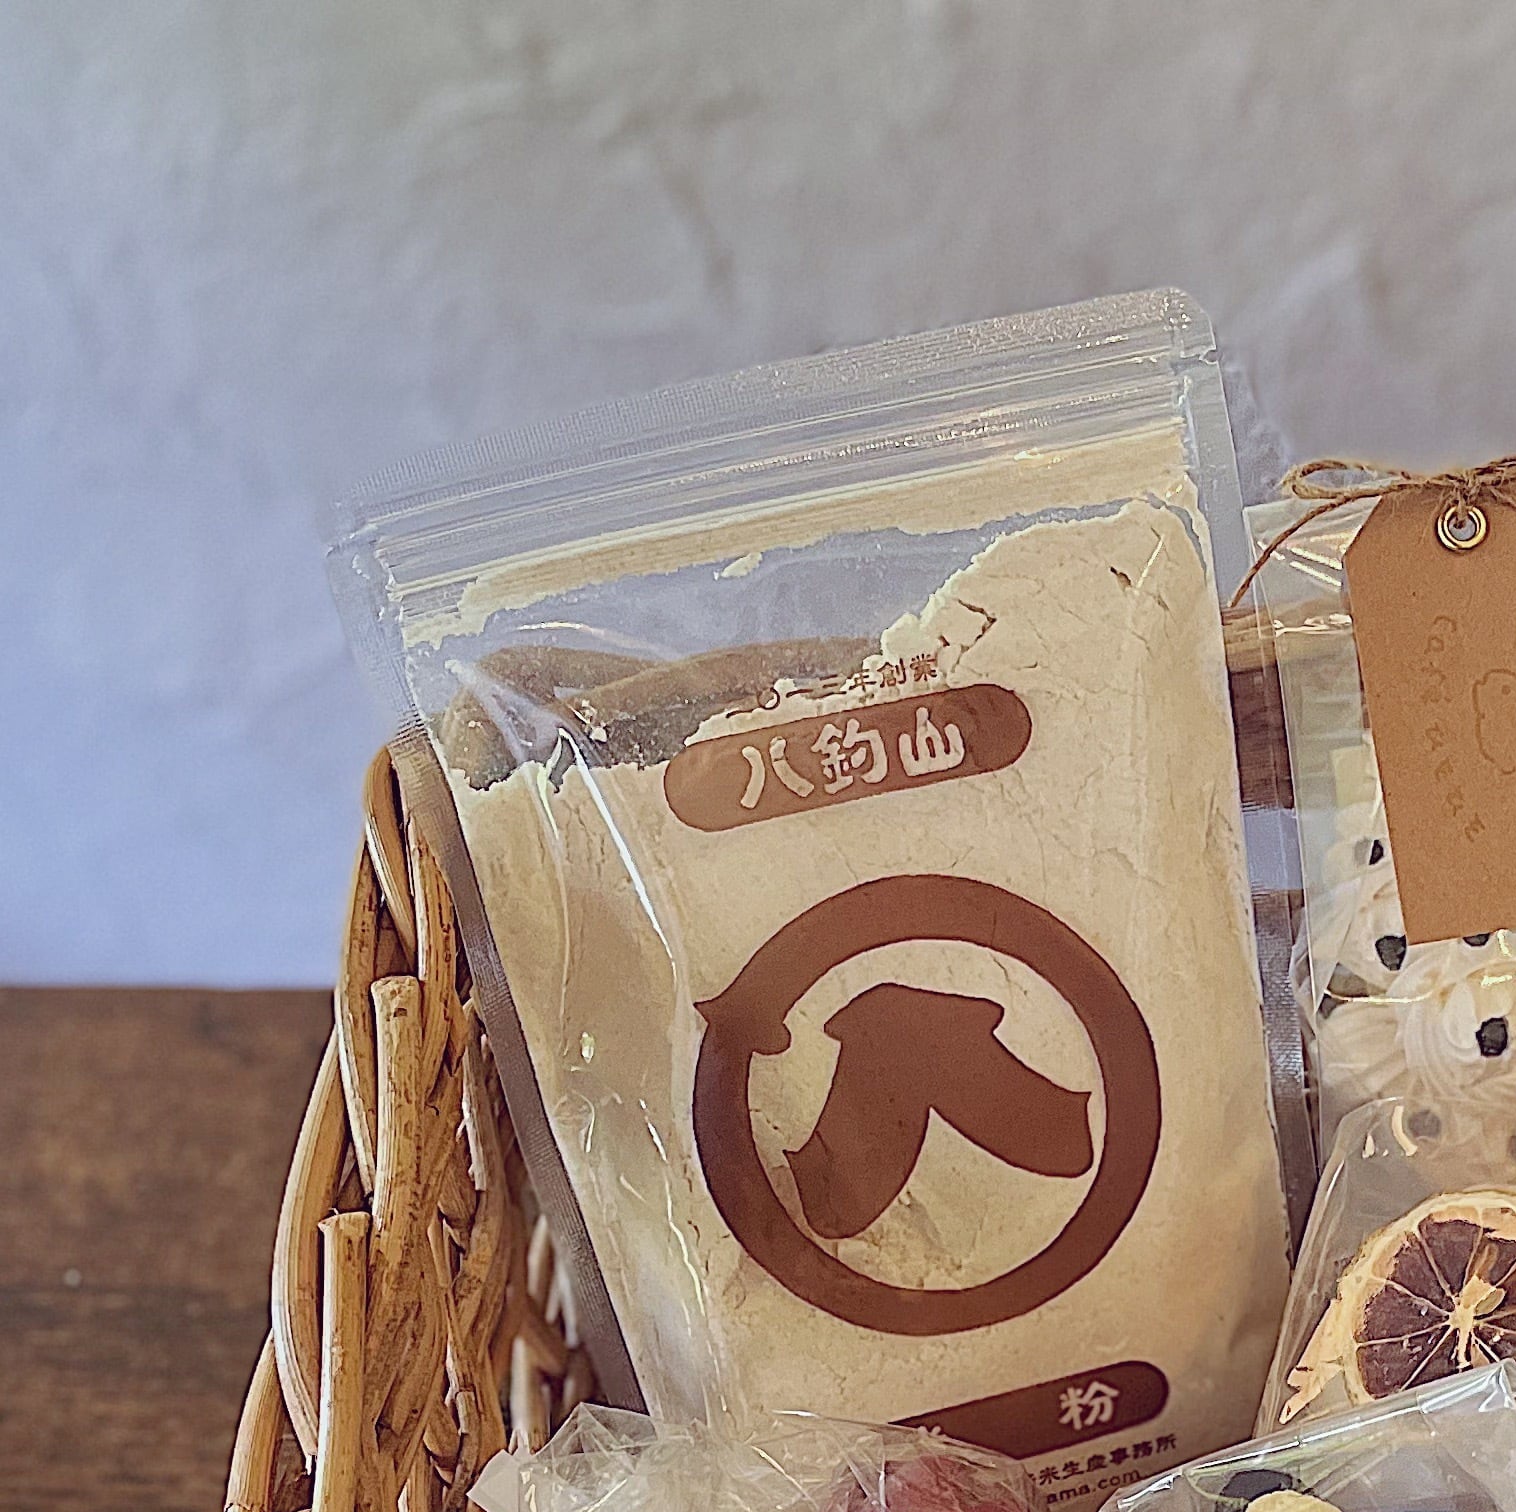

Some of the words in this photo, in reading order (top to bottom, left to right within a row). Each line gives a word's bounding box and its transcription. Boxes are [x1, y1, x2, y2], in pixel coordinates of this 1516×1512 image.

[739, 706, 966, 810] 八釣山
[1028, 1433, 1177, 1486] 米生産事務所
[1046, 1468, 1141, 1504] ama.com
